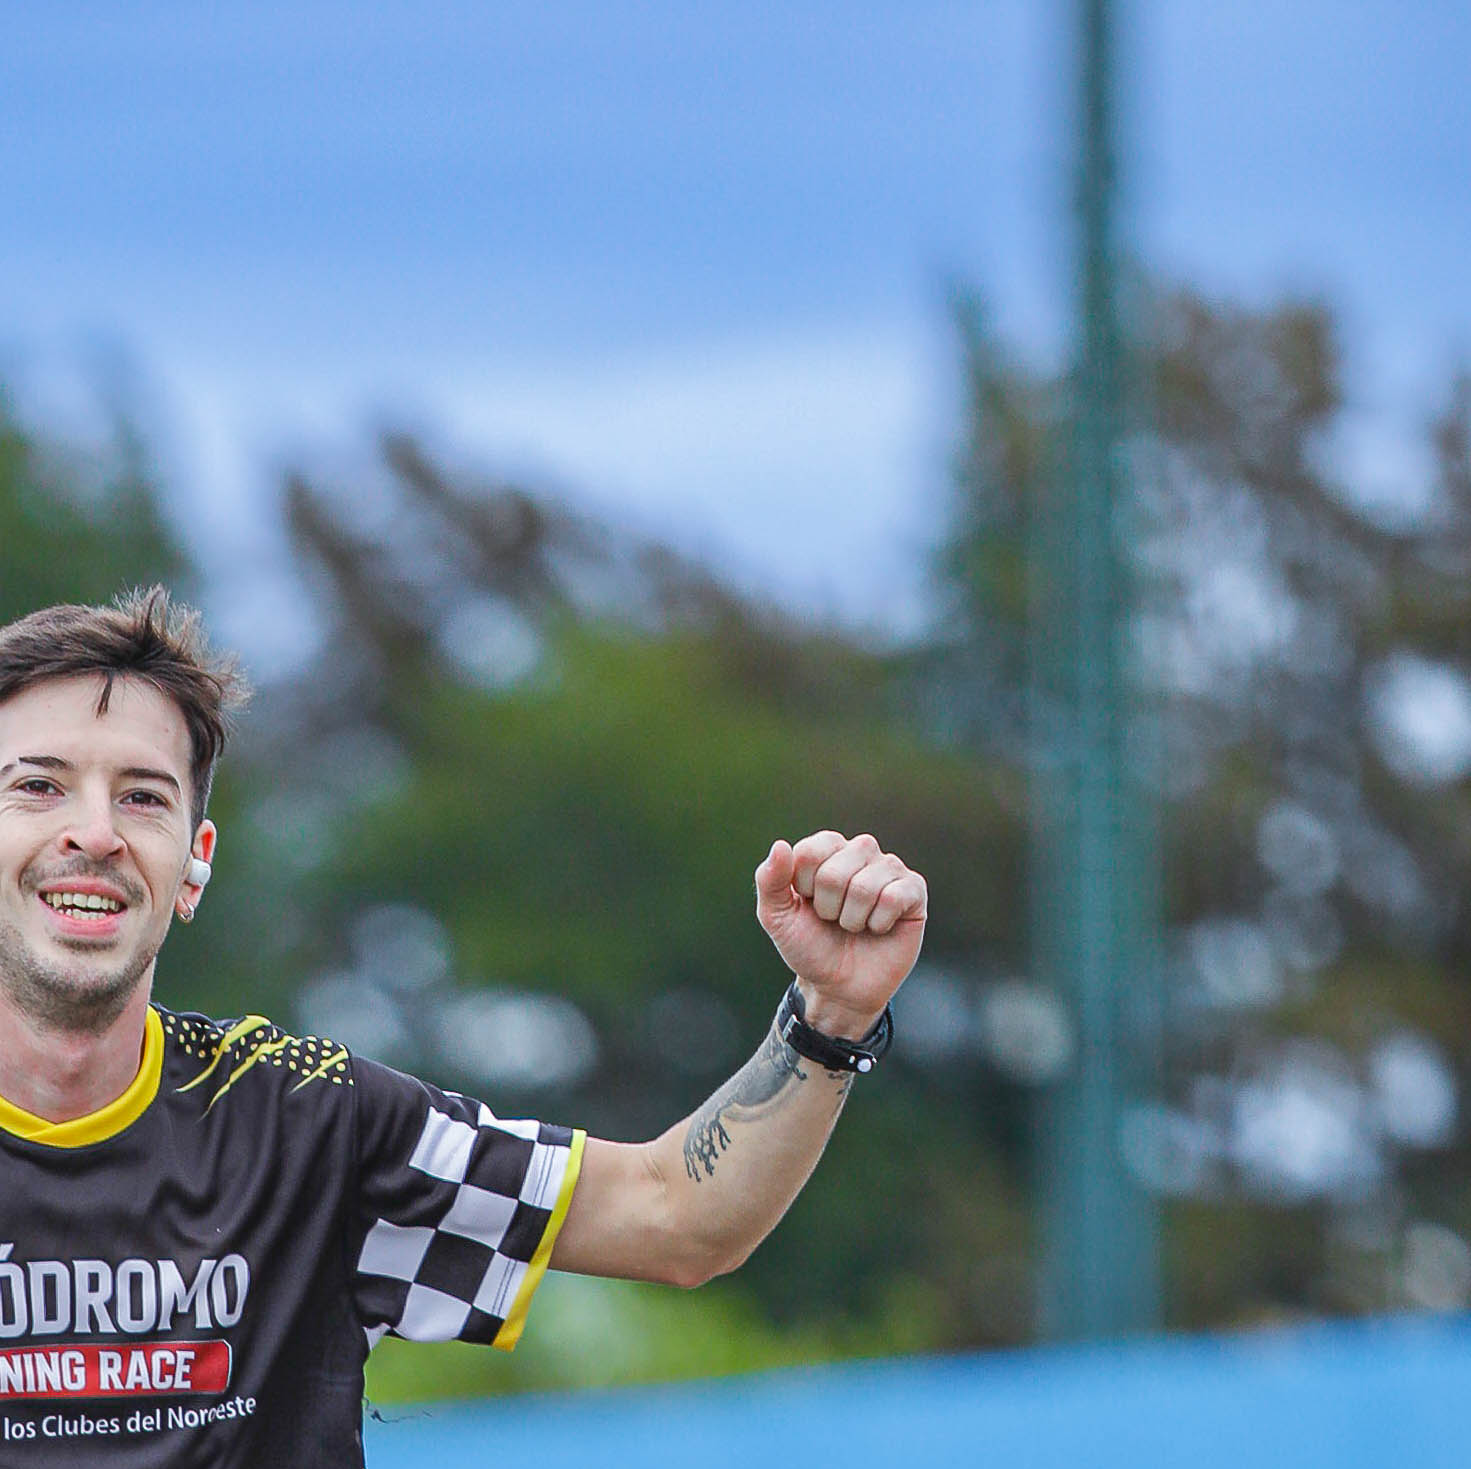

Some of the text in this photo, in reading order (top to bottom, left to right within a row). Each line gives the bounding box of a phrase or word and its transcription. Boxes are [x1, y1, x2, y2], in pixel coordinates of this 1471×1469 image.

[98, 1349, 196, 1391] RACE
[4, 1416, 36, 1441] los
[41, 1414, 120, 1437] Clubes
[126, 1408, 161, 1434] del
[167, 1395, 257, 1431] Noroeste
